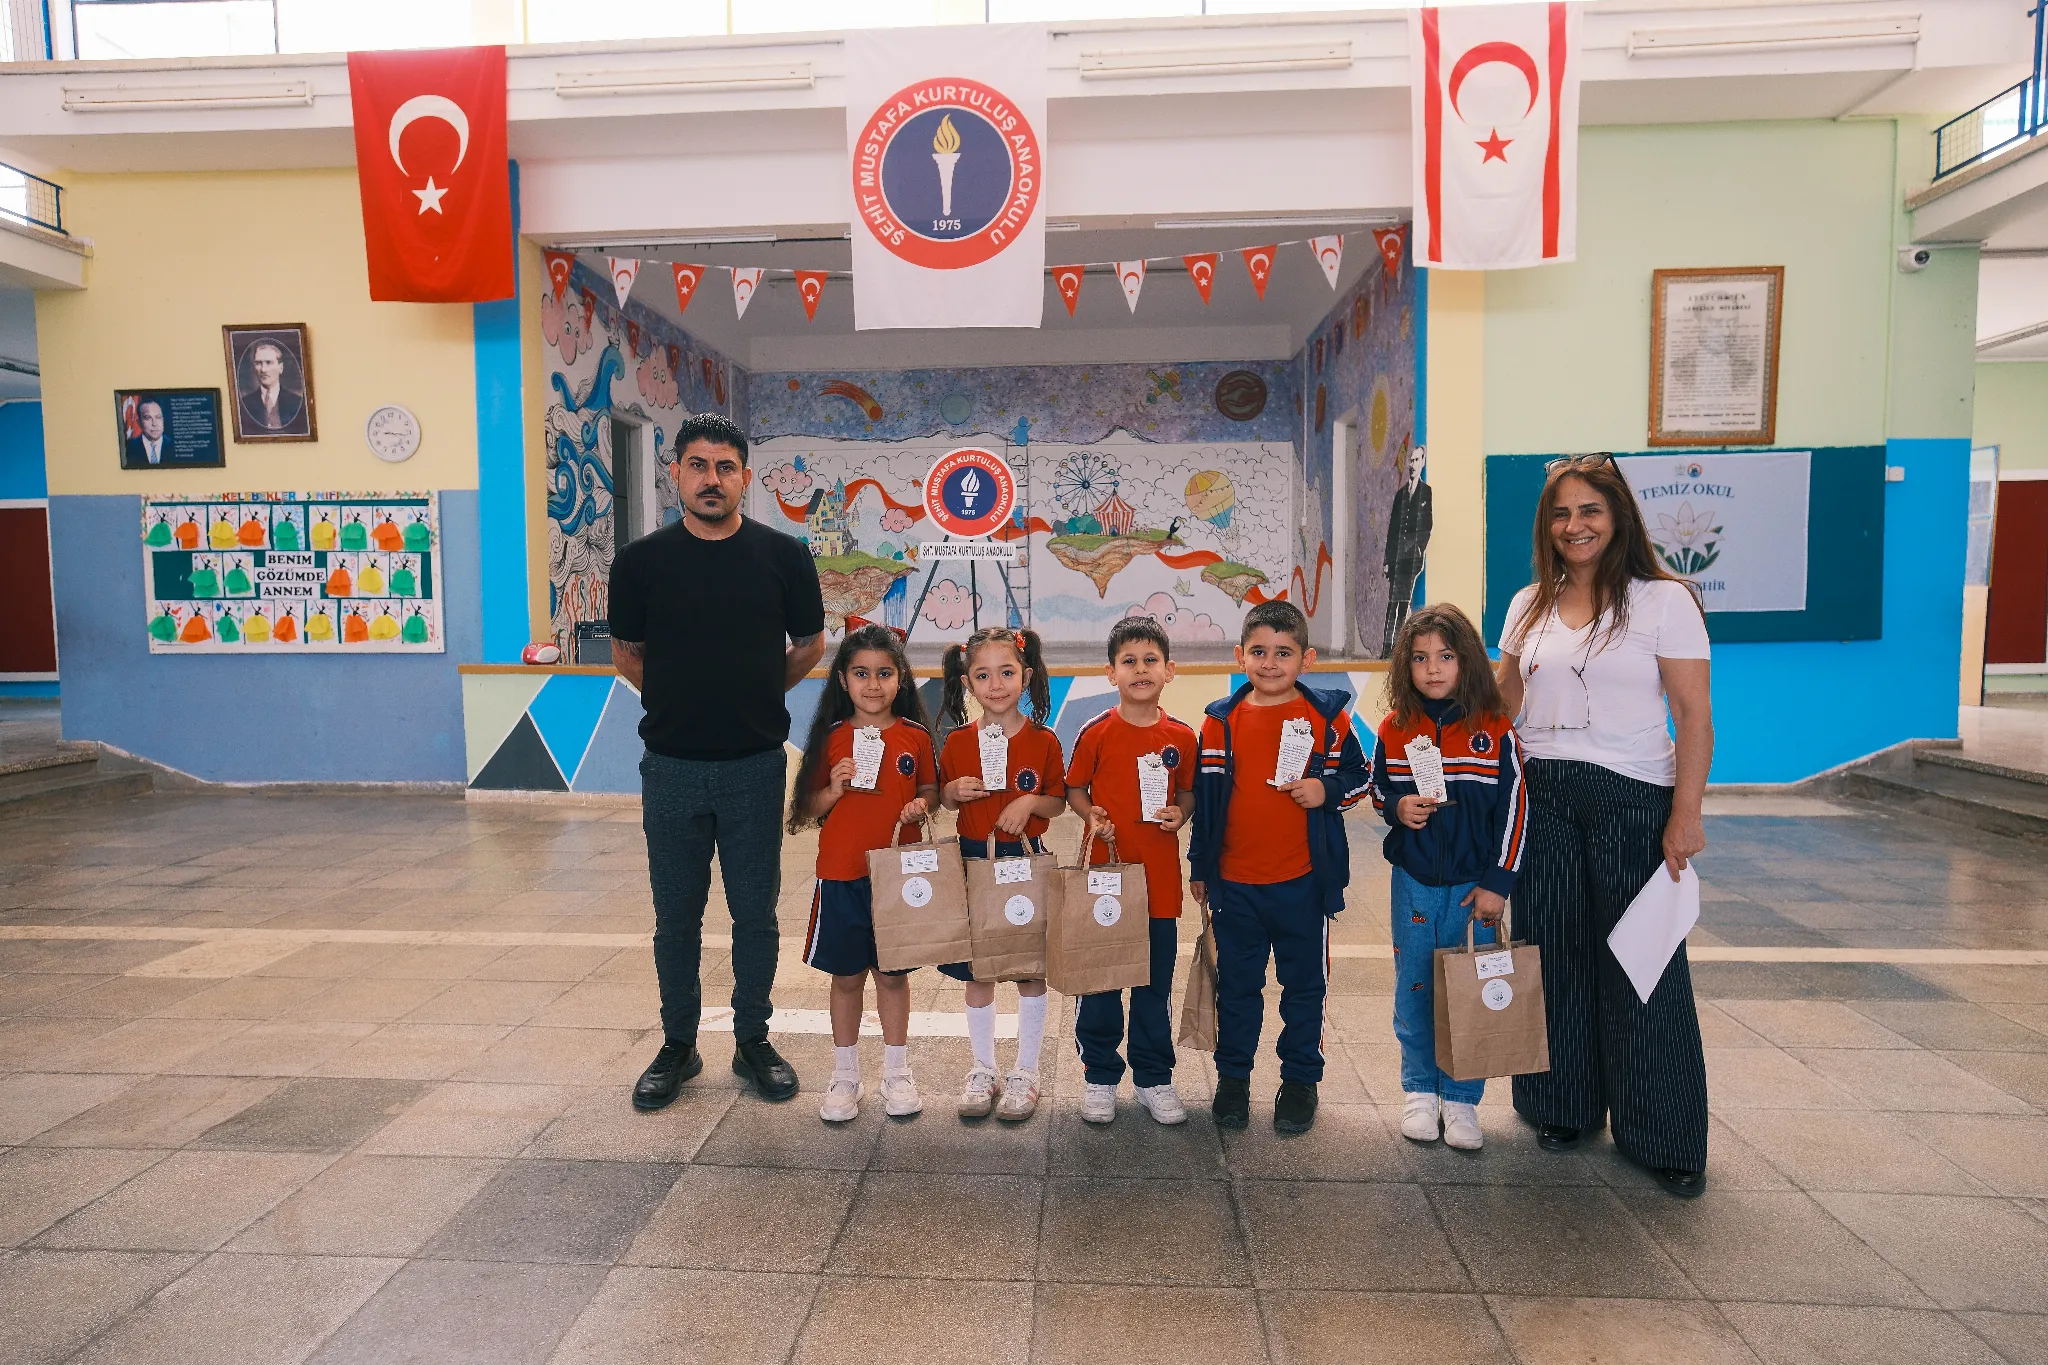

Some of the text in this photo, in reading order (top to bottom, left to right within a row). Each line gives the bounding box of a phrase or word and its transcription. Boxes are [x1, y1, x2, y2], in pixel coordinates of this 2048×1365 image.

[859, 85, 1033, 246] ŞEHİT MUSTAFA KURTULUŞ ANAOKULU
[932, 219, 962, 231] 1975
[931, 460, 957, 496] MUSTAFA
[956, 454, 1002, 475] KURTULUŞ
[989, 475, 1009, 523] ANAOKULU
[1639, 481, 1736, 501] TEMİZ OKUL
[222, 491, 296, 502] KELEBEKLER
[934, 545, 957, 557] MUSTAFA
[958, 545, 986, 559] KURTULUŞ
[986, 545, 1014, 557] ANAOKULU
[256, 568, 325, 582] GÖZÜMDE
[263, 586, 313, 596] ANNEM
